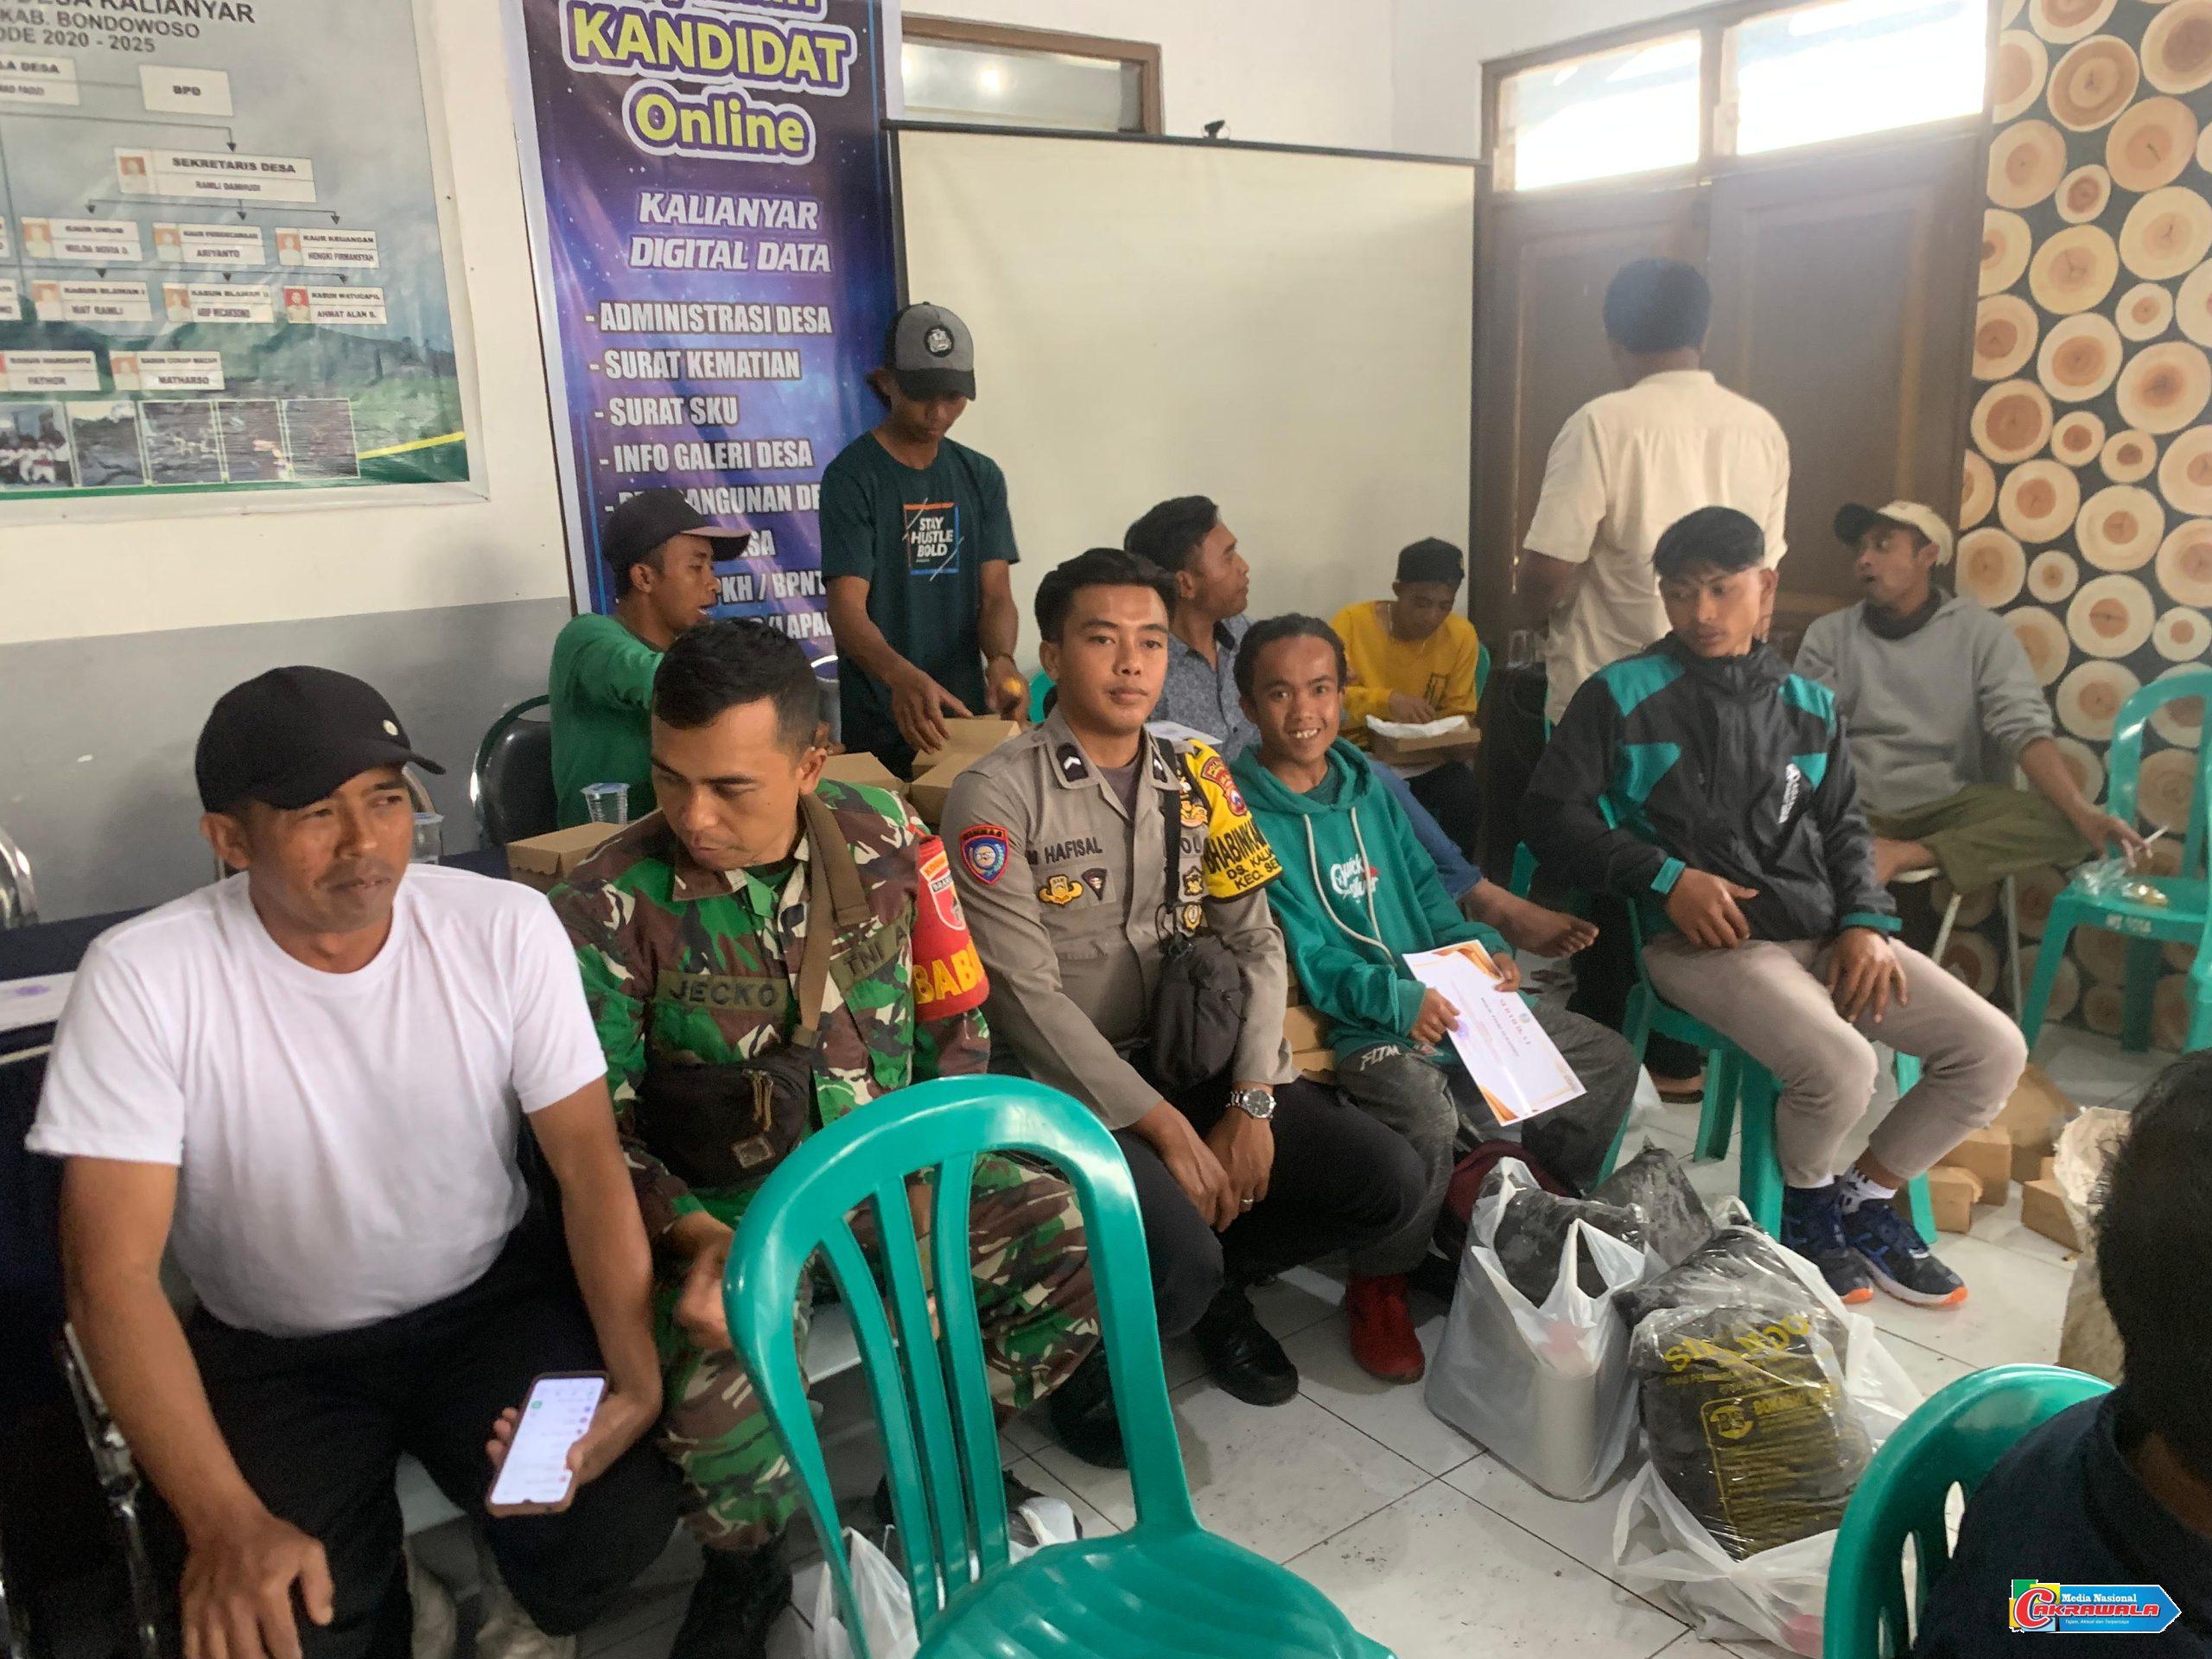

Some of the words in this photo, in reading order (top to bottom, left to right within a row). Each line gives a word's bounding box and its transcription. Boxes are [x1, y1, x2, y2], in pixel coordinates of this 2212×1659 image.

[57, 10, 200, 39] BONDOWOSO
[42, 29, 90, 48] 2020
[109, 35, 156, 53] 2025
[572, 7, 846, 83] KANDIDAT
[636, 93, 805, 153] Online
[172, 157, 258, 172] SEKRETARIS
[260, 162, 296, 174] DESA
[638, 192, 818, 231] KALIANYAR
[629, 237, 749, 270] DIGITAL
[756, 242, 831, 273] DATA
[600, 302, 772, 332] ADMINISTRASI
[776, 307, 833, 334] DESA
[605, 350, 682, 379] SURAT
[686, 351, 802, 379] KEMATIAN
[609, 397, 683, 426] SURAT
[690, 397, 739, 425] SKU
[613, 443, 669, 473] INFO
[673, 441, 753, 471] GALERI
[756, 440, 813, 467] DESA
[911, 529, 954, 544] HUSTLE
[918, 516, 944, 531] STAY
[917, 543, 948, 557] BOLD
[1044, 836, 1103, 865] HAFISAL
[669, 978, 777, 1009] JECKO
